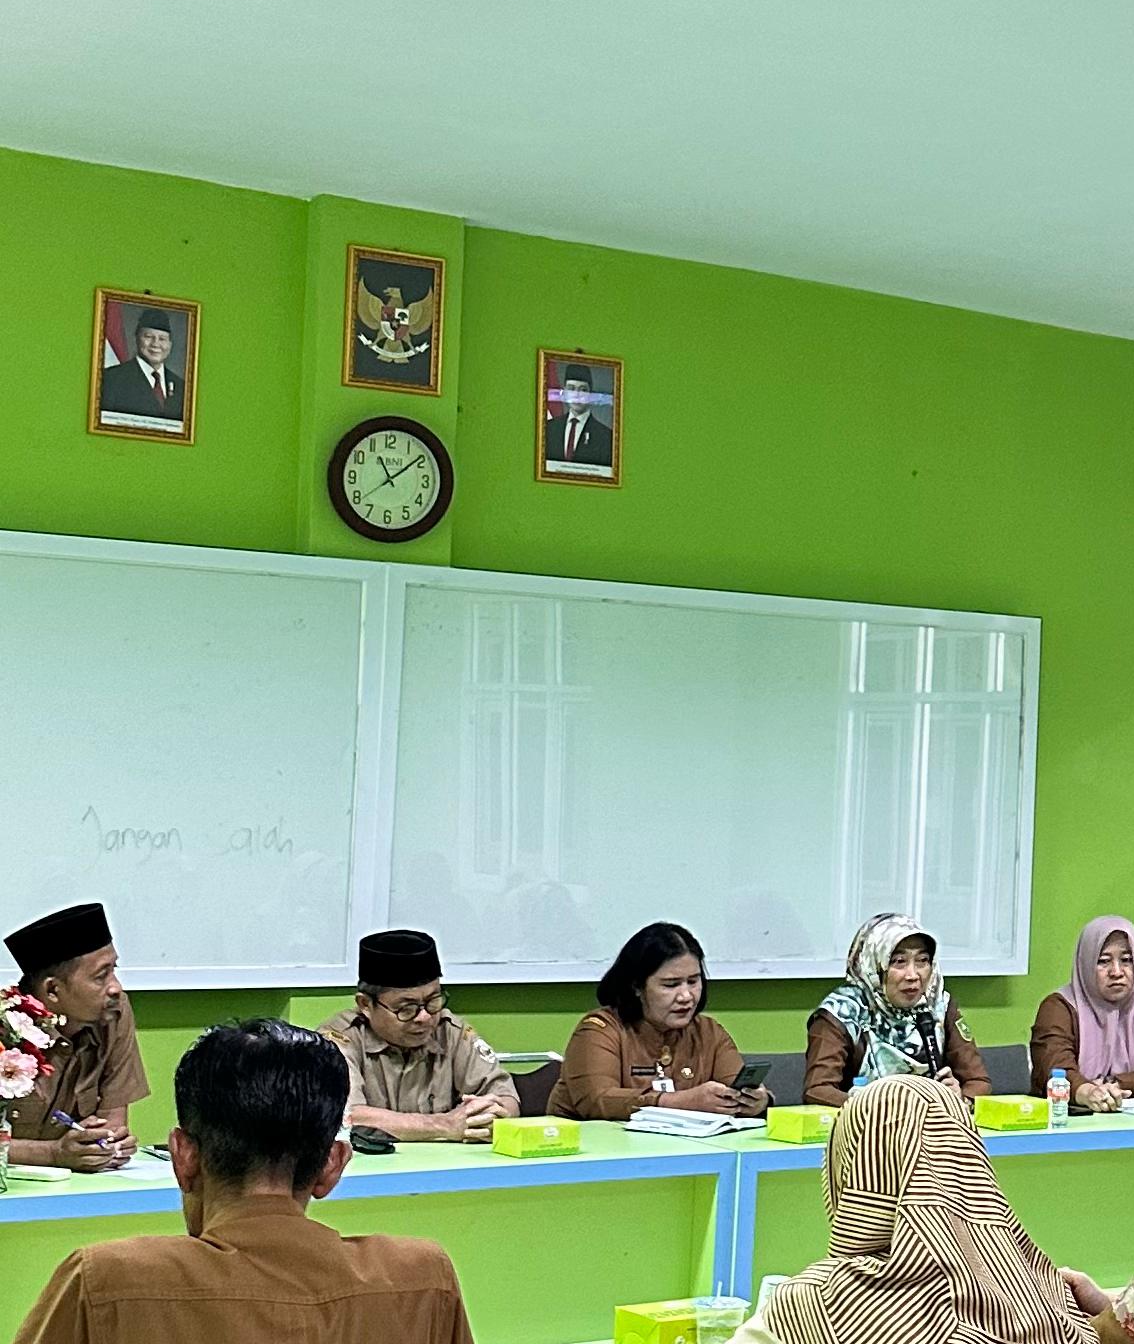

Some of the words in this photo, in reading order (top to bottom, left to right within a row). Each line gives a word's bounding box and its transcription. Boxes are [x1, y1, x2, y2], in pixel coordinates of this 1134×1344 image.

[369, 438, 376, 453] 11
[384, 434, 397, 449] 12
[406, 440, 411, 455] 1
[353, 450, 365, 465] 10
[385, 457, 403, 466] BNI
[417, 454, 426, 469] 2
[347, 470, 357, 485] 9
[421, 474, 430, 489] 3
[352, 490, 361, 505] 8
[414, 492, 423, 507] 4
[364, 503, 374, 518] 7
[383, 509, 392, 524] 6
[401, 505, 410, 520] 5
